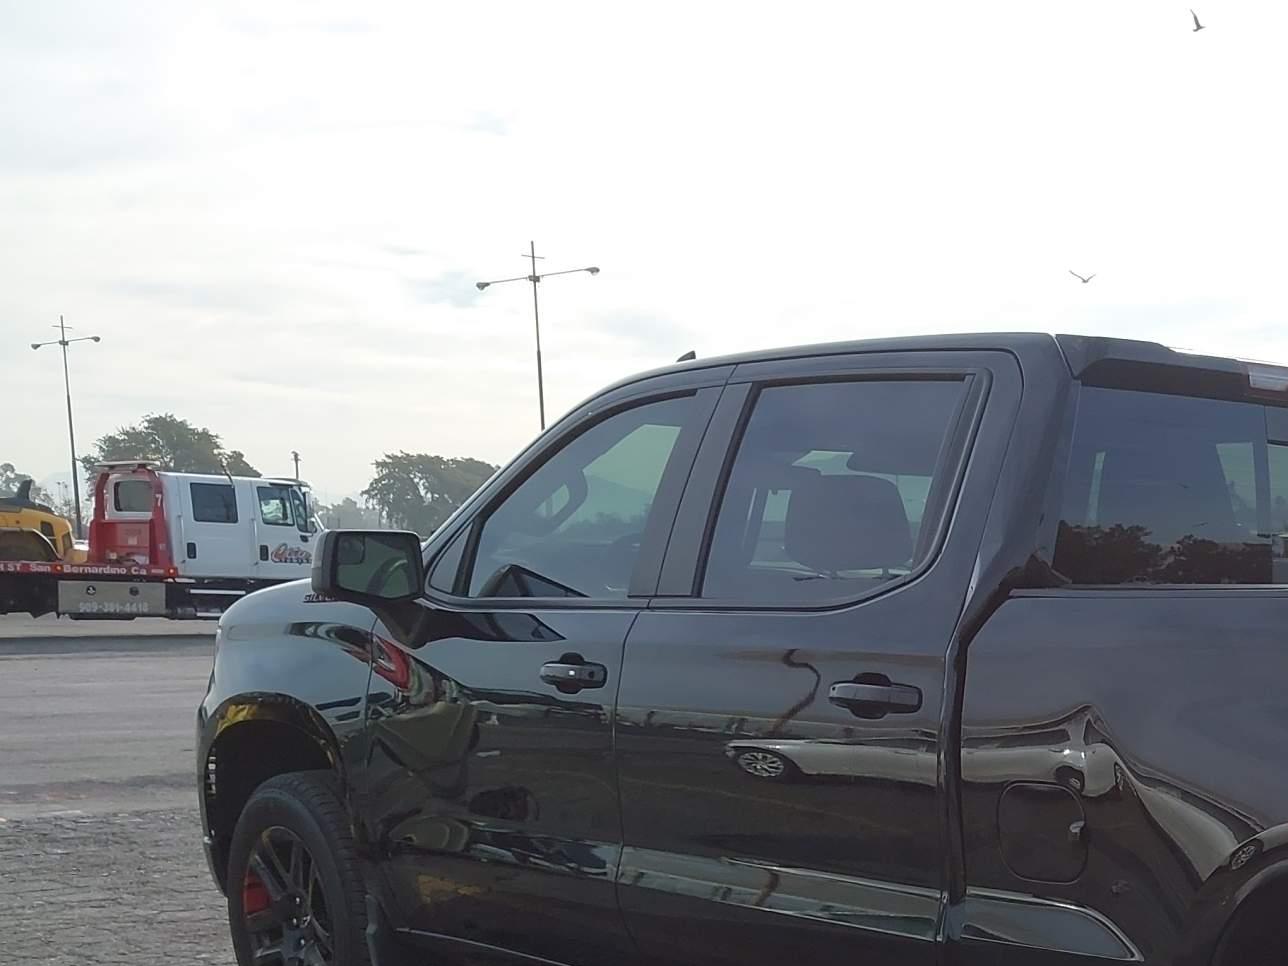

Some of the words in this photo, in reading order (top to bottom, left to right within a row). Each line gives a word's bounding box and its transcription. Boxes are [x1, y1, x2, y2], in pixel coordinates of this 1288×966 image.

[30, 564, 51, 573] San
[64, 565, 127, 575] Bernardino
[131, 566, 147, 576] Ca
